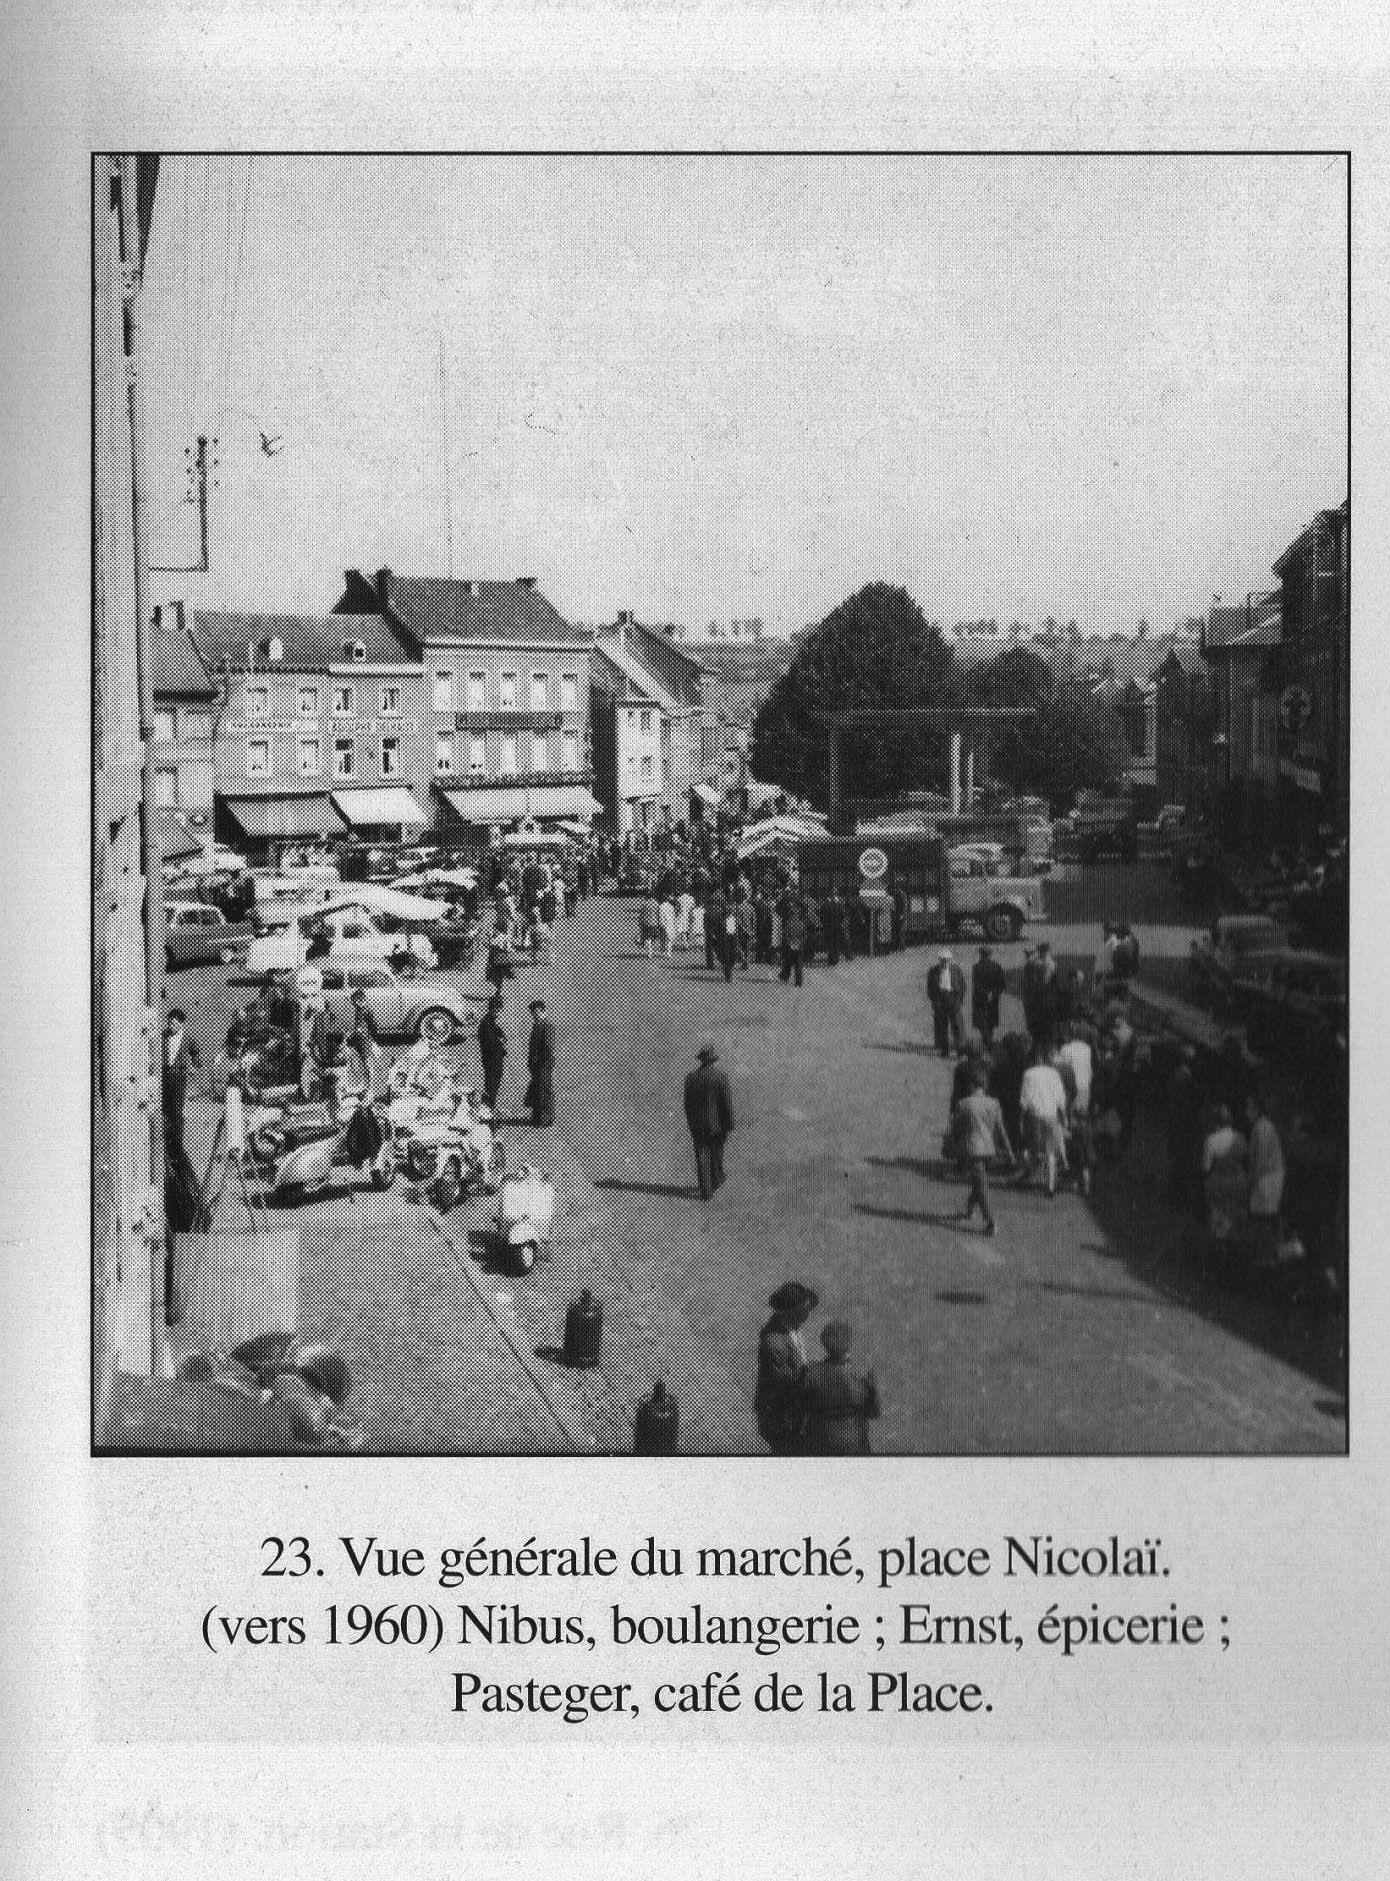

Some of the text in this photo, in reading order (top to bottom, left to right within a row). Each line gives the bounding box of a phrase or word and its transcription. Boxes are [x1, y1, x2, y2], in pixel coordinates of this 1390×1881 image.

[260, 1535, 1171, 1589] 23. Vue générale du marché, place Nicolaï.
[201, 1602, 307, 1655] (vers
[325, 1603, 445, 1655] 1960)
[456, 1603, 597, 1653] Nibus,
[609, 1602, 861, 1657] boulangerie
[899, 1603, 1024, 1651] Ernst,
[1036, 1602, 1205, 1657] épicerie
[450, 1670, 994, 1725] Pasteger, café de la Place.
